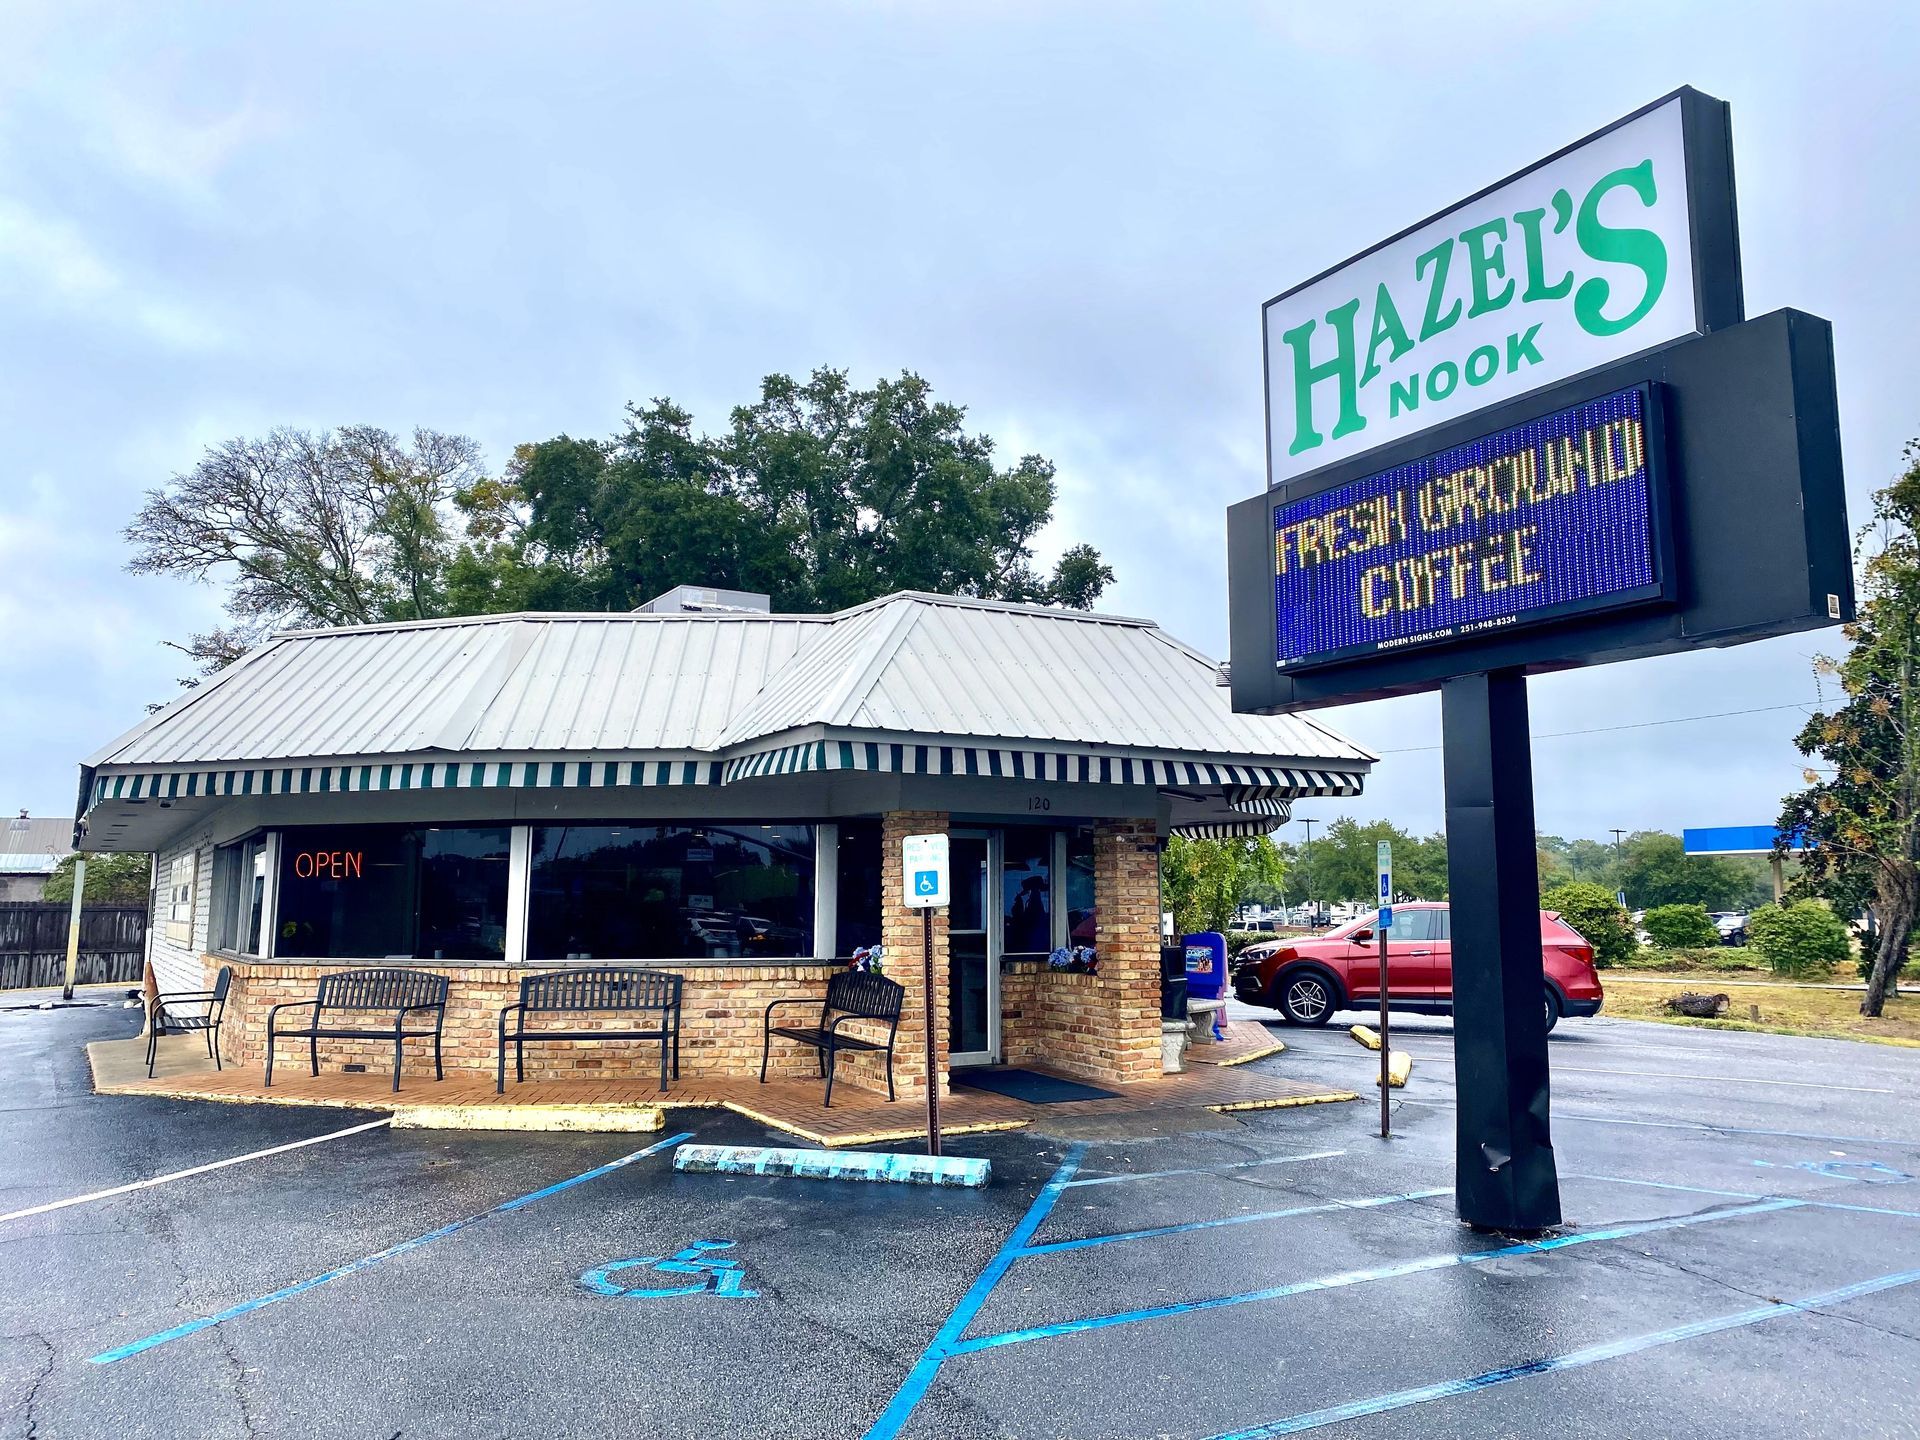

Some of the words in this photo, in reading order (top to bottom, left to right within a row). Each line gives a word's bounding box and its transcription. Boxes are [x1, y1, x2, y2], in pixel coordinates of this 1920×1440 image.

[1282, 159, 1668, 457] HAZEL'S
[1389, 323, 1544, 418] NOOK
[1276, 490, 1407, 576] FRESH
[1419, 417, 1645, 532] GROUND
[1360, 525, 1542, 619] COFFEE
[1377, 636, 1409, 650] MODERN
[1409, 627, 1453, 643] SIGNS.COM
[1460, 614, 1517, 633] 251-948-8334
[1029, 796, 1050, 811] 120
[295, 852, 363, 878] OPEN
[906, 841, 946, 852] RESVED
